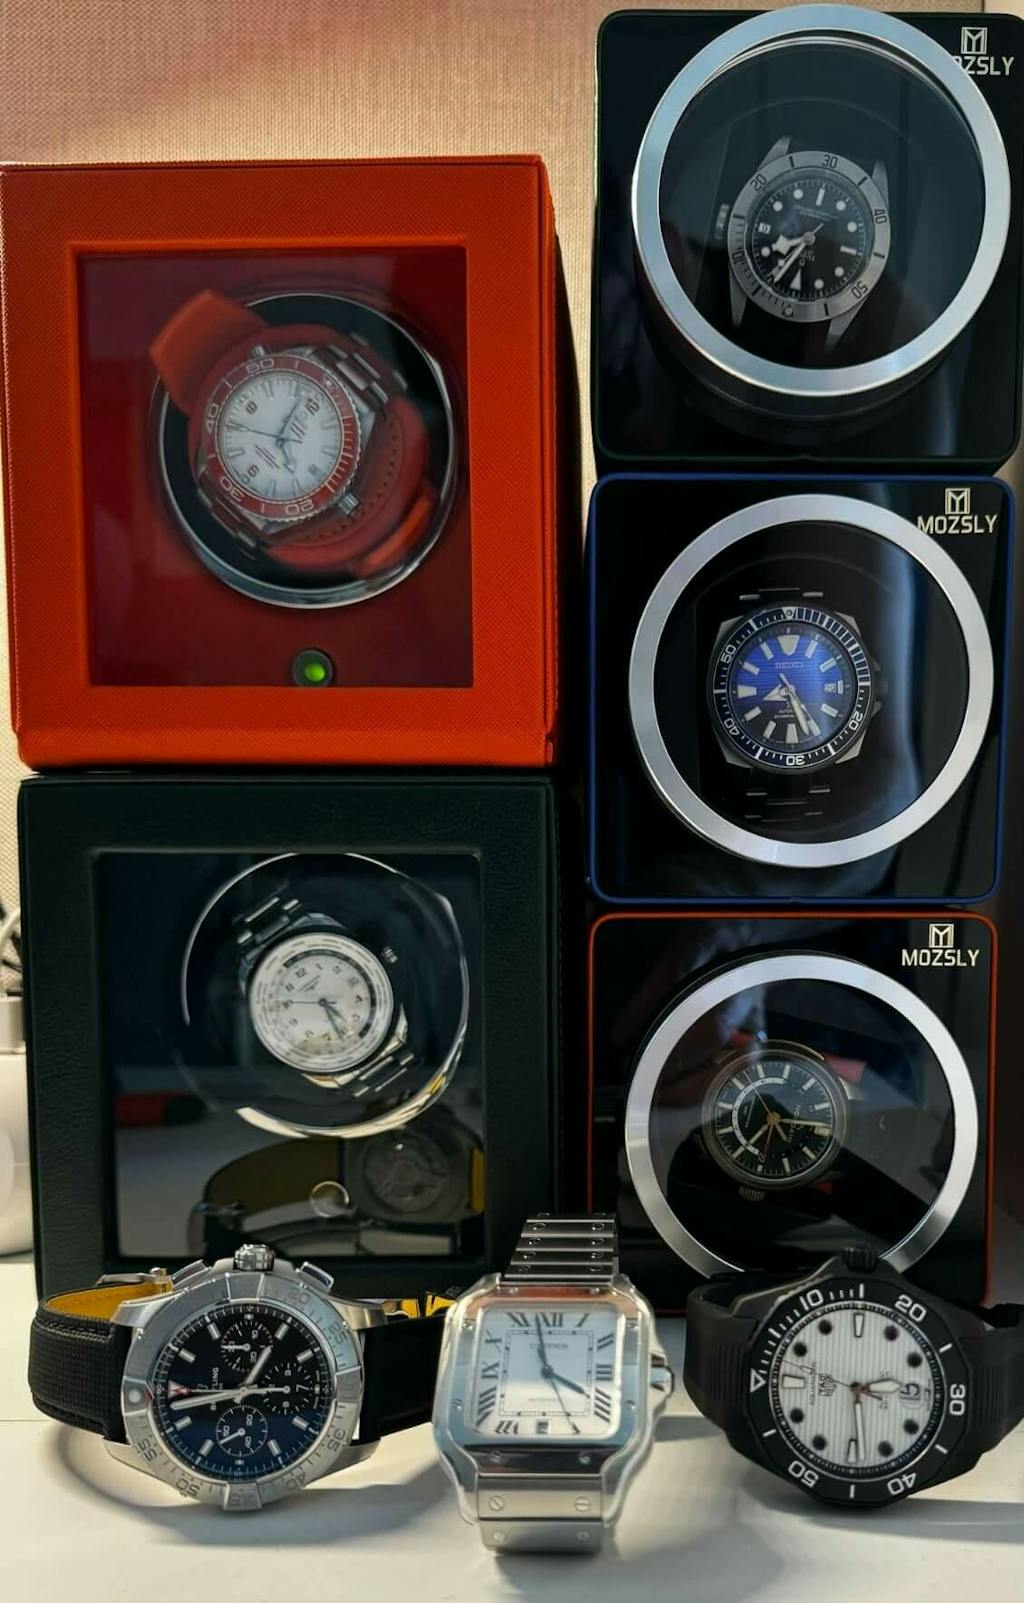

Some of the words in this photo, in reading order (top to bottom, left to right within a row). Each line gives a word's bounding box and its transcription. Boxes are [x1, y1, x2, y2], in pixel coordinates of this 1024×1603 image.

[953, 55, 1015, 76] ZSLY
[822, 153, 838, 169] 30
[750, 173, 768, 192] 20
[874, 209, 888, 224] 40
[851, 280, 869, 299] 50
[245, 358, 275, 375] 50
[206, 403, 219, 432] 40
[220, 477, 245, 503] 30
[284, 498, 315, 515] 20
[917, 514, 998, 535] MOZSLY
[720, 643, 736, 663] 50
[723, 718, 740, 736] 40
[848, 710, 864, 732] 20
[786, 755, 806, 766] 30
[901, 948, 980, 967] MOZSLY
[799, 1288, 825, 1311] 10
[894, 1294, 927, 1322] 20
[949, 1383, 966, 1416] 30
[138, 1438, 157, 1462] 55
[327, 1428, 347, 1452] 35
[788, 1460, 820, 1488] 50
[887, 1472, 918, 1496] 40
[175, 1478, 200, 1498] 50
